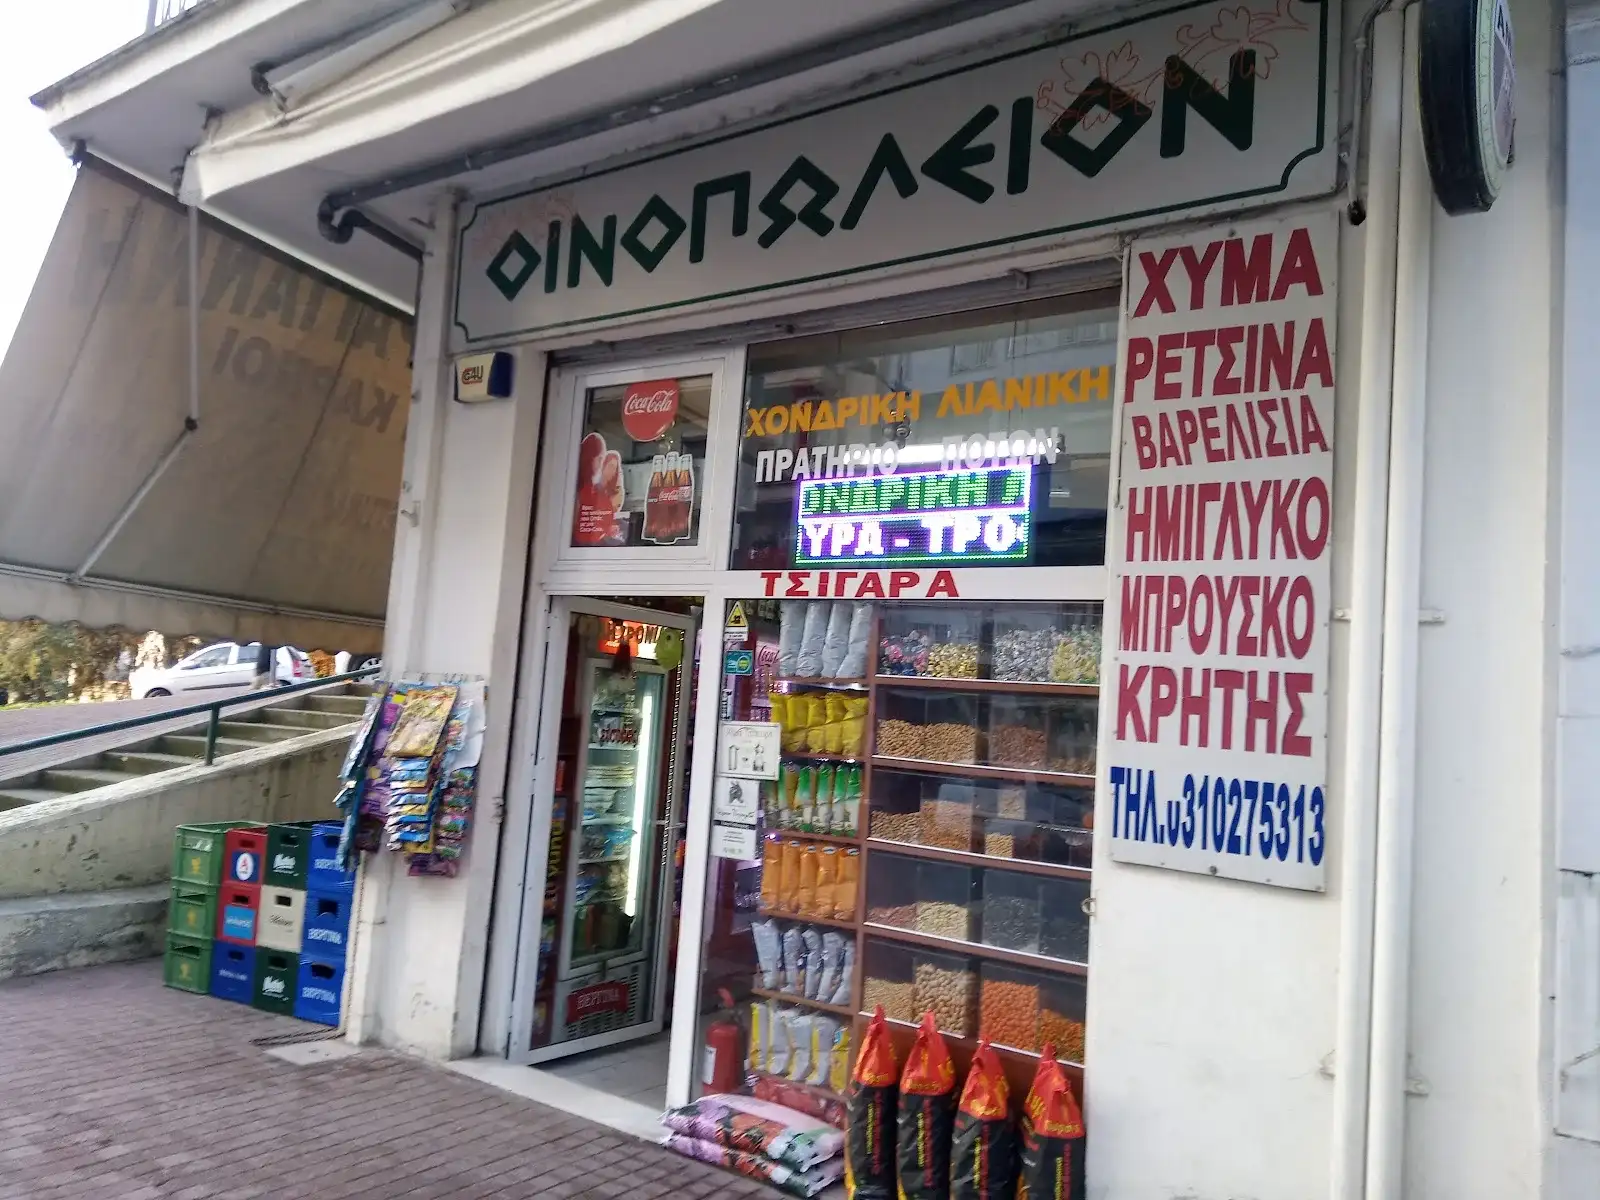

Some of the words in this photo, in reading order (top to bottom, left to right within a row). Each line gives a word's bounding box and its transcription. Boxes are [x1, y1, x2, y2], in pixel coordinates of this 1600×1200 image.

[486, 48, 1256, 301] ΟΙΝΟΠΩΛΕΙΟΝ
[1133, 227, 1324, 318] ΧΥΜΑ
[745, 390, 921, 438] ΧΟΝΔΡΙΚΗ
[936, 365, 1110, 418] ΛΙΑΝΙΚΗ
[1124, 317, 1334, 403] ΡΕΤΣΙΝΑ
[755, 440, 899, 483] ΠΡΑΤΗΡΙΟ
[1131, 394, 1331, 471] ΒΑΡΕΛΙΣΙΑ
[1125, 476, 1331, 562] ΗΜΙΓΛΥΚΟ
[760, 571, 960, 597] ΤΣΙΓΑΡΑ
[1118, 574, 1315, 660] ΜΠΡΟΥΣΚΟ
[1116, 664, 1314, 757] ΚΡΗΤΗΣ
